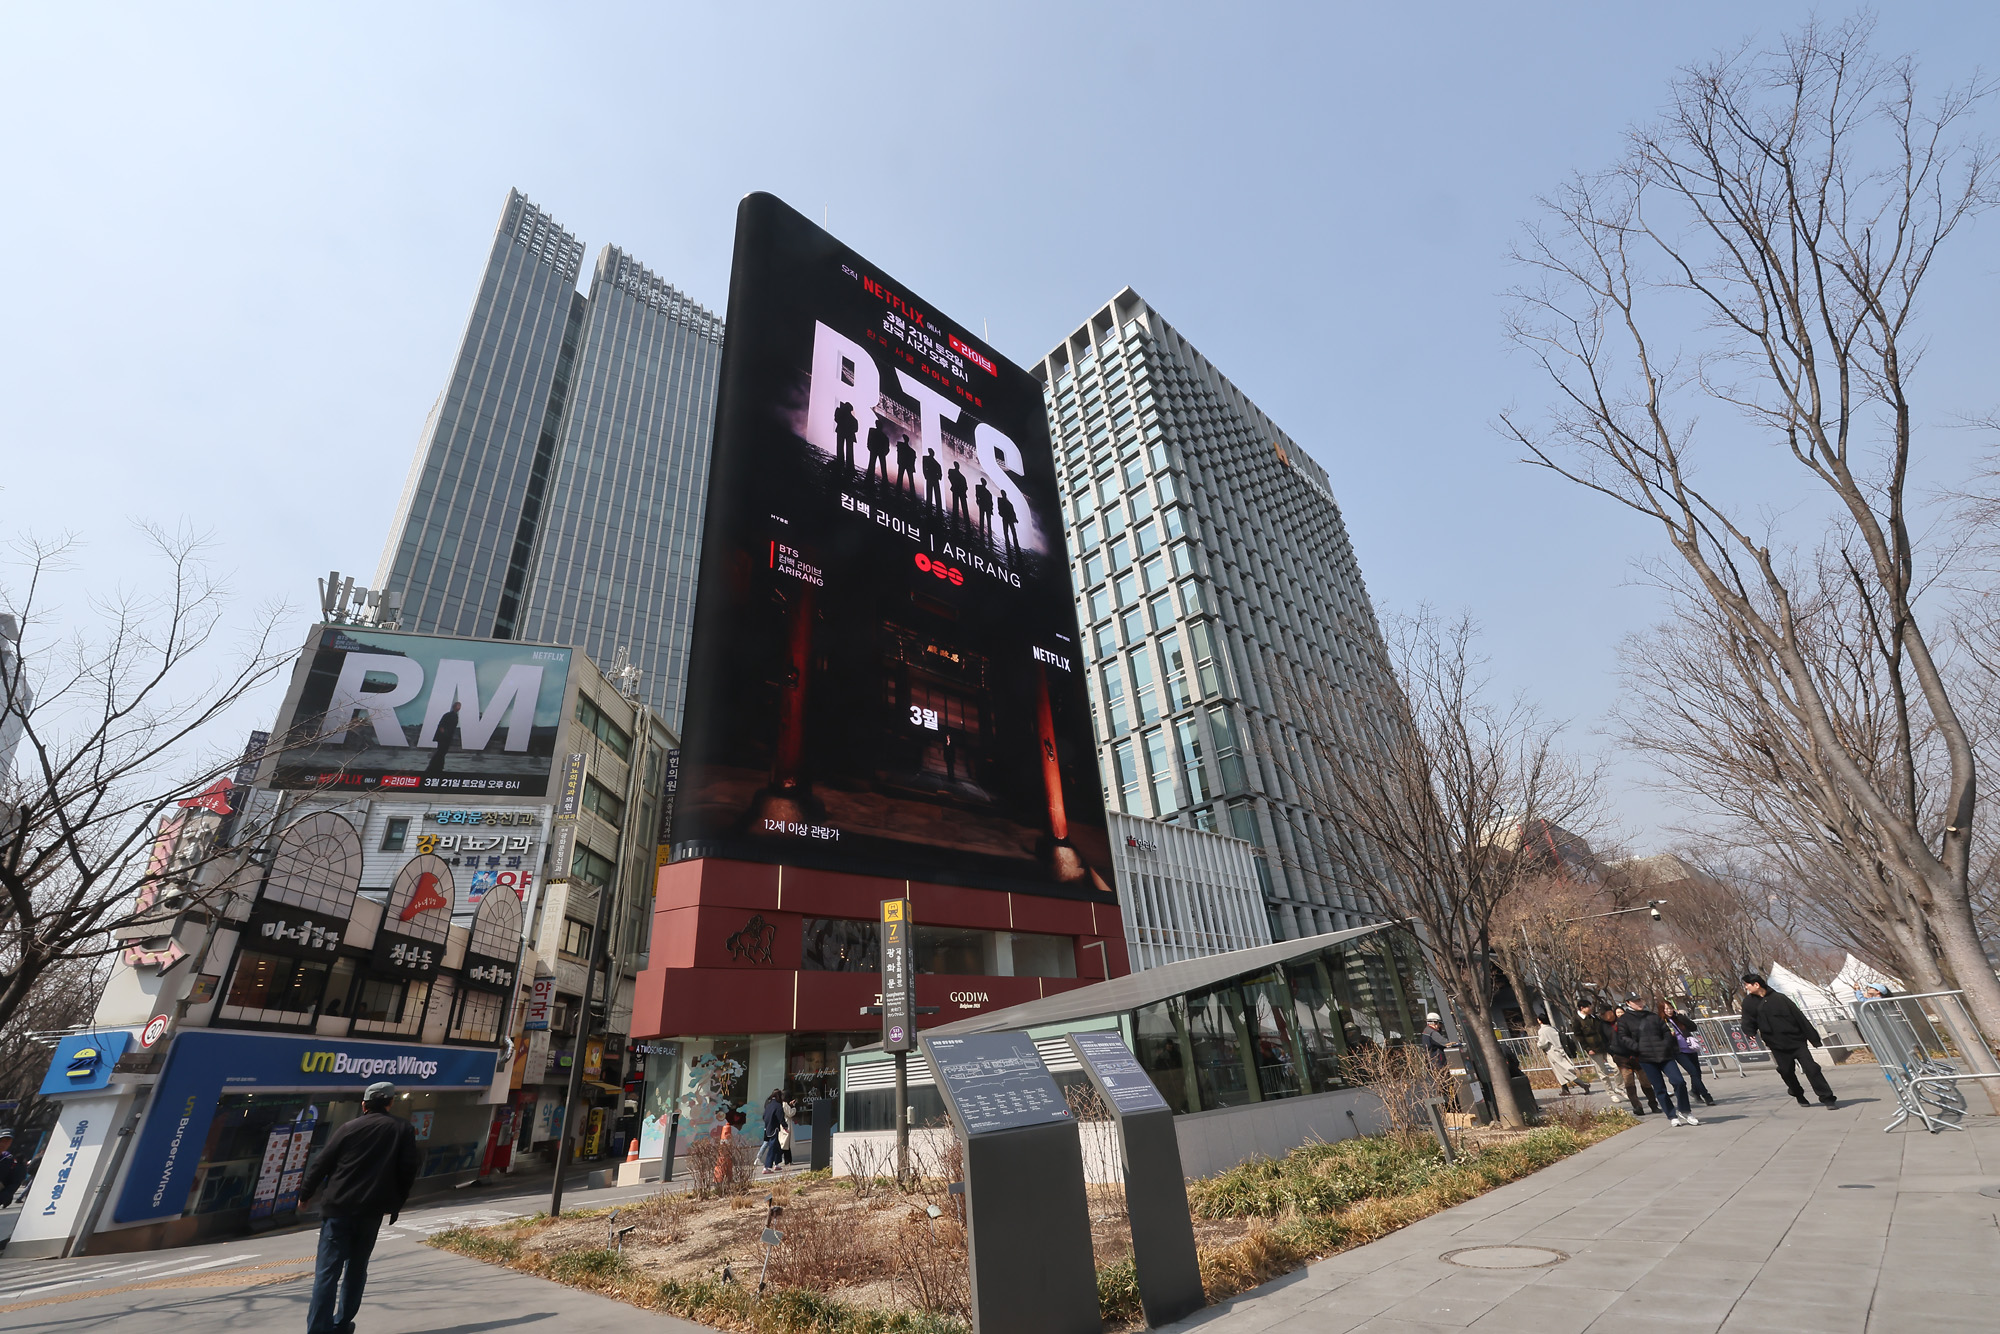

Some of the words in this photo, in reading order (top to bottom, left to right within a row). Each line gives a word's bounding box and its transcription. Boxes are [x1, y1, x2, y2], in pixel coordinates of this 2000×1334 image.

[841, 264, 858, 280] 오직
[863, 274, 924, 329] NETFLIX
[926, 321, 942, 337] 에서
[882, 319, 905, 341] 한국
[906, 335, 927, 356] 시간
[929, 350, 949, 369] 오후
[951, 364, 969, 383] 8시
[886, 311, 906, 331] 3월
[908, 325, 933, 349] 21일
[935, 342, 964, 369] 토요일
[960, 343, 993, 372] 라이브
[779, 544, 799, 558] BTS
[841, 493, 871, 519] 컴백
[876, 509, 921, 543] 라이브
[943, 542, 1021, 588] ARIRANG
[778, 554, 795, 568] 컴백
[797, 561, 822, 577] 라이브
[778, 564, 824, 587] ARIRANG
[532, 651, 565, 661] NETFLIX
[1032, 645, 1071, 673] NETFLIX
[319, 652, 544, 752] RM
[909, 705, 939, 731] 3월
[317, 774, 363, 785] NETFLIX
[390, 777, 417, 786] 라이브
[424, 778, 440, 787] 3월
[441, 779, 461, 788] 21일
[461, 780, 487, 789] 토요일
[487, 780, 504, 789] 오후
[505, 781, 520, 789] 8시
[666, 757, 679, 791] 한의원
[764, 819, 785, 833] 12세
[788, 822, 808, 837] 이상
[811, 825, 840, 841] 관람가
[416, 833, 534, 855] 강비뇨기과
[464, 855, 522, 869] 피부과
[889, 924, 898, 936] 7
[389, 943, 433, 970] 청담동
[886, 947, 896, 989] 광화문
[530, 981, 552, 1020] 약국
[950, 991, 989, 1002] GODIVA
[146, 1023, 162, 1040] 30
